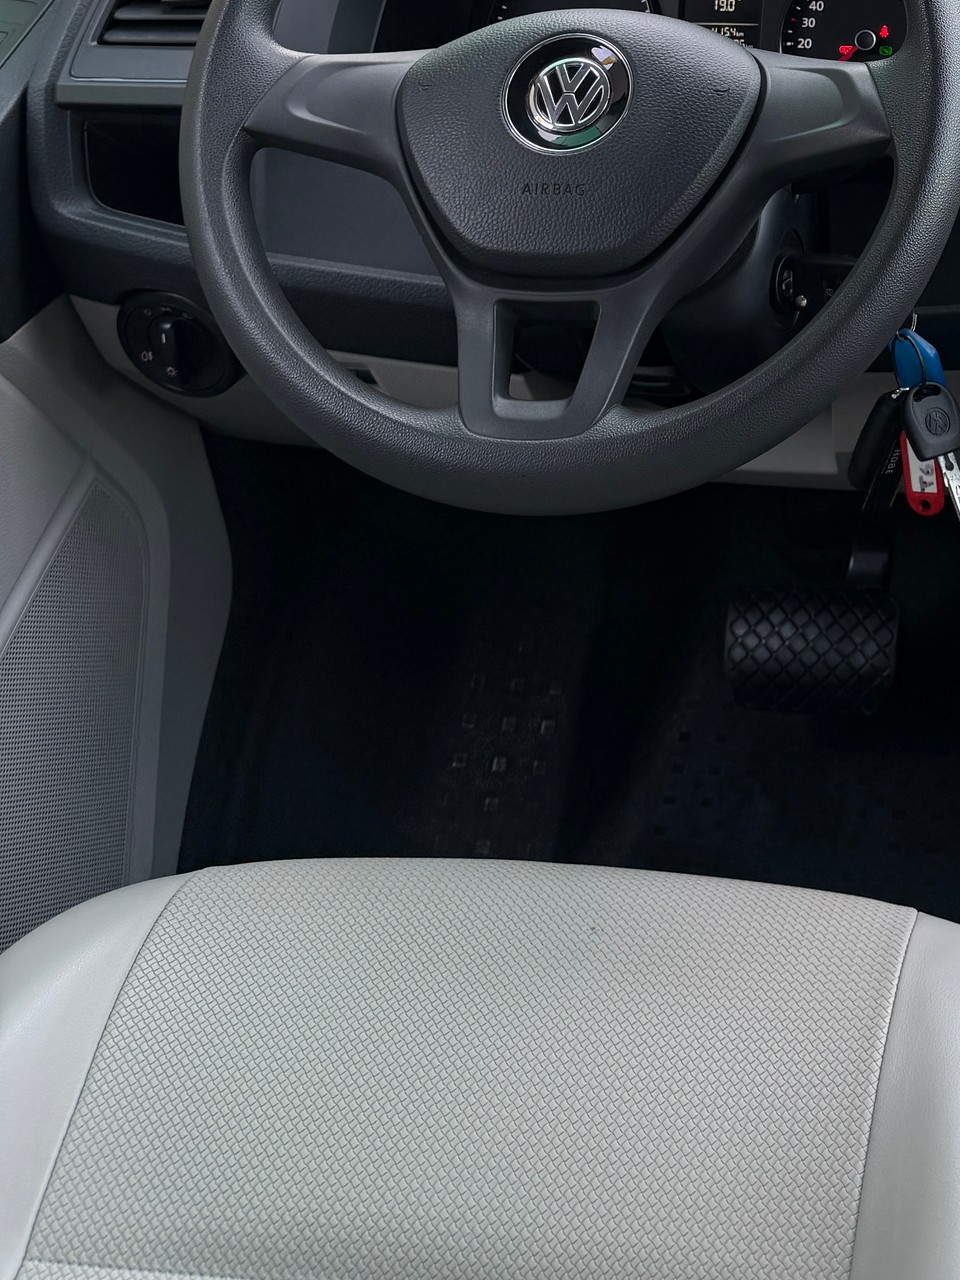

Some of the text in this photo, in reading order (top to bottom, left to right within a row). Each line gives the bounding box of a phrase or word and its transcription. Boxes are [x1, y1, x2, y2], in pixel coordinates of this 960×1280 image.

[808, 0, 824, 12] 40
[801, 17, 816, 28] 30
[797, 38, 813, 49] 20
[521, 182, 585, 197] AIRBAG
